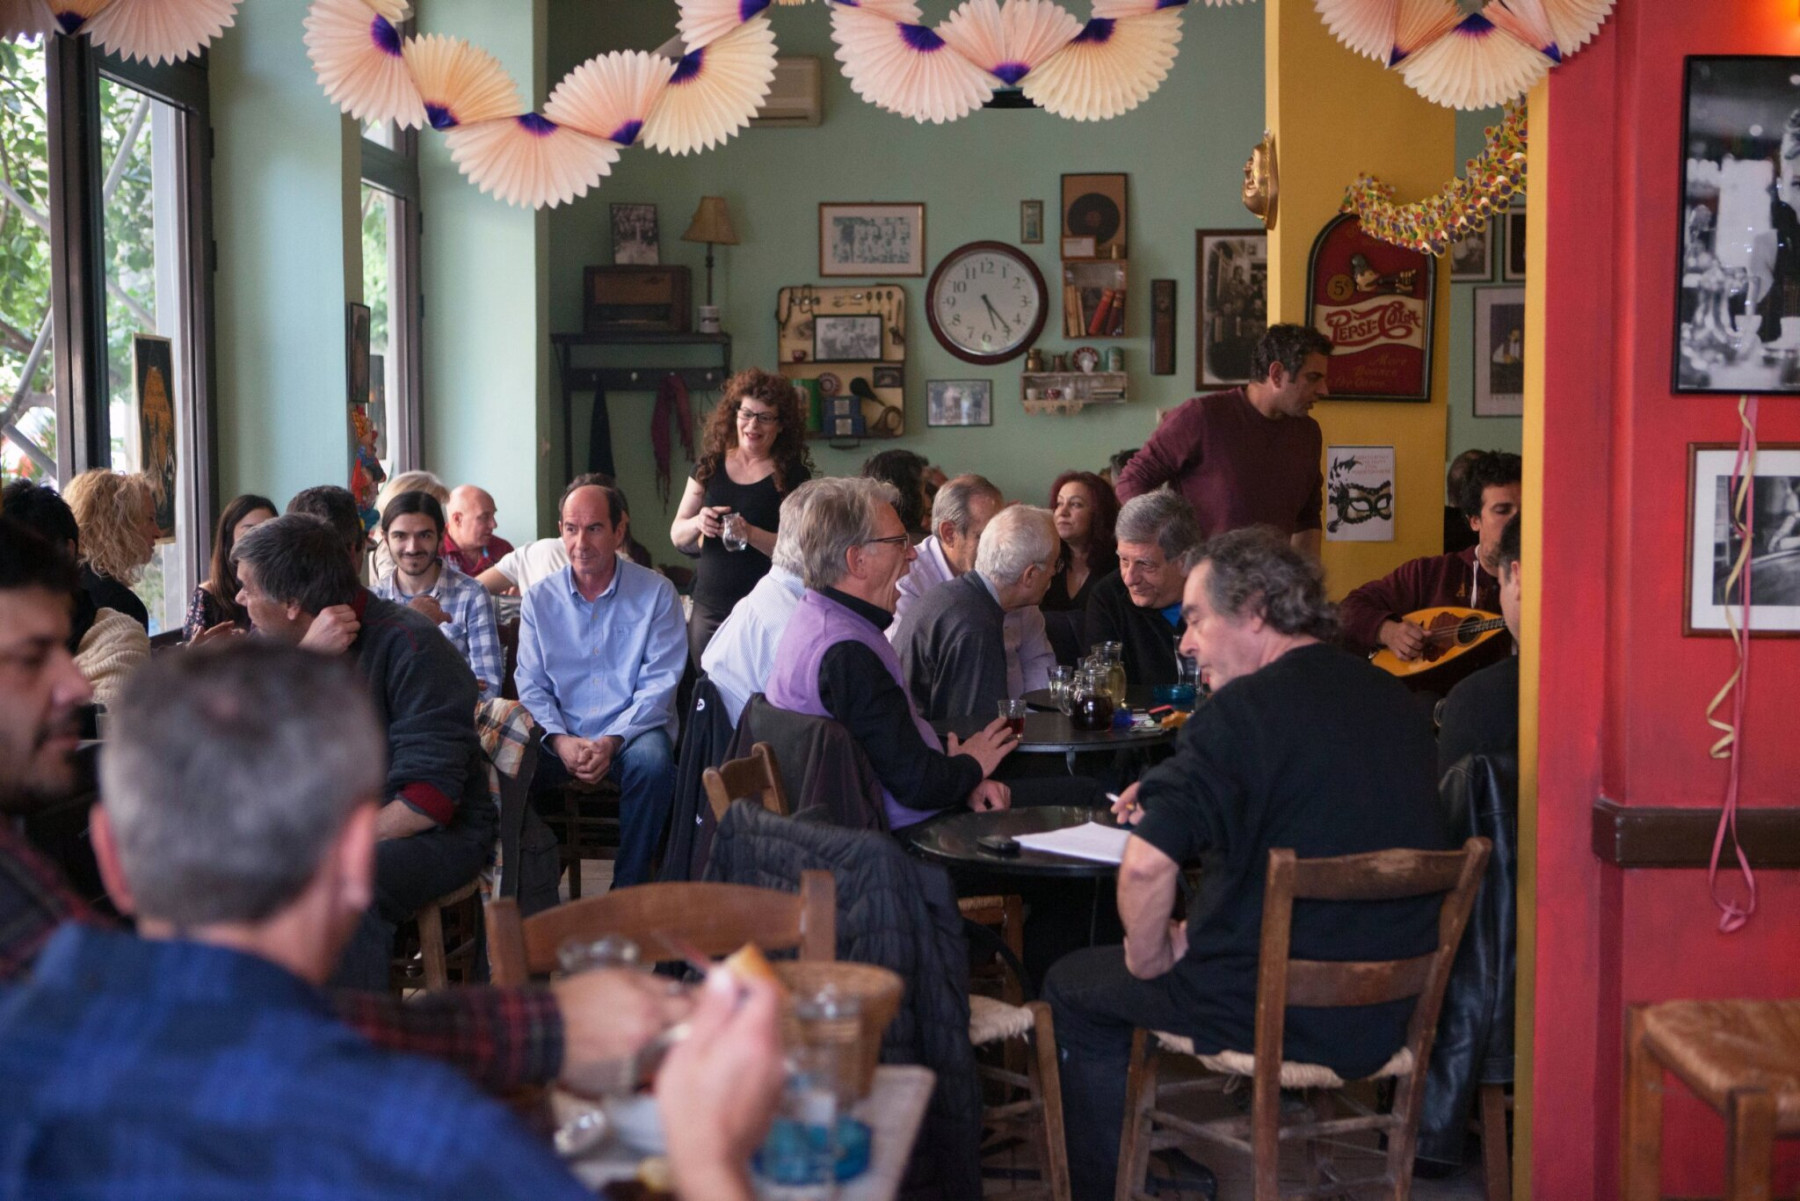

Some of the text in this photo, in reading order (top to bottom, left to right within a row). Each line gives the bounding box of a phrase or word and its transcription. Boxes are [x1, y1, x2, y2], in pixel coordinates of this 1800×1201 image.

[965, 266, 976, 280] 11
[980, 261, 995, 274] 12
[1002, 266, 1007, 279] 1
[953, 281, 967, 294] 10
[1013, 277, 1021, 290] 2
[946, 296, 956, 308] 9
[1020, 296, 1028, 308] 3
[952, 314, 961, 326] 8
[1012, 313, 1022, 325] 4
[967, 327, 975, 339] 7
[982, 332, 992, 344] 6
